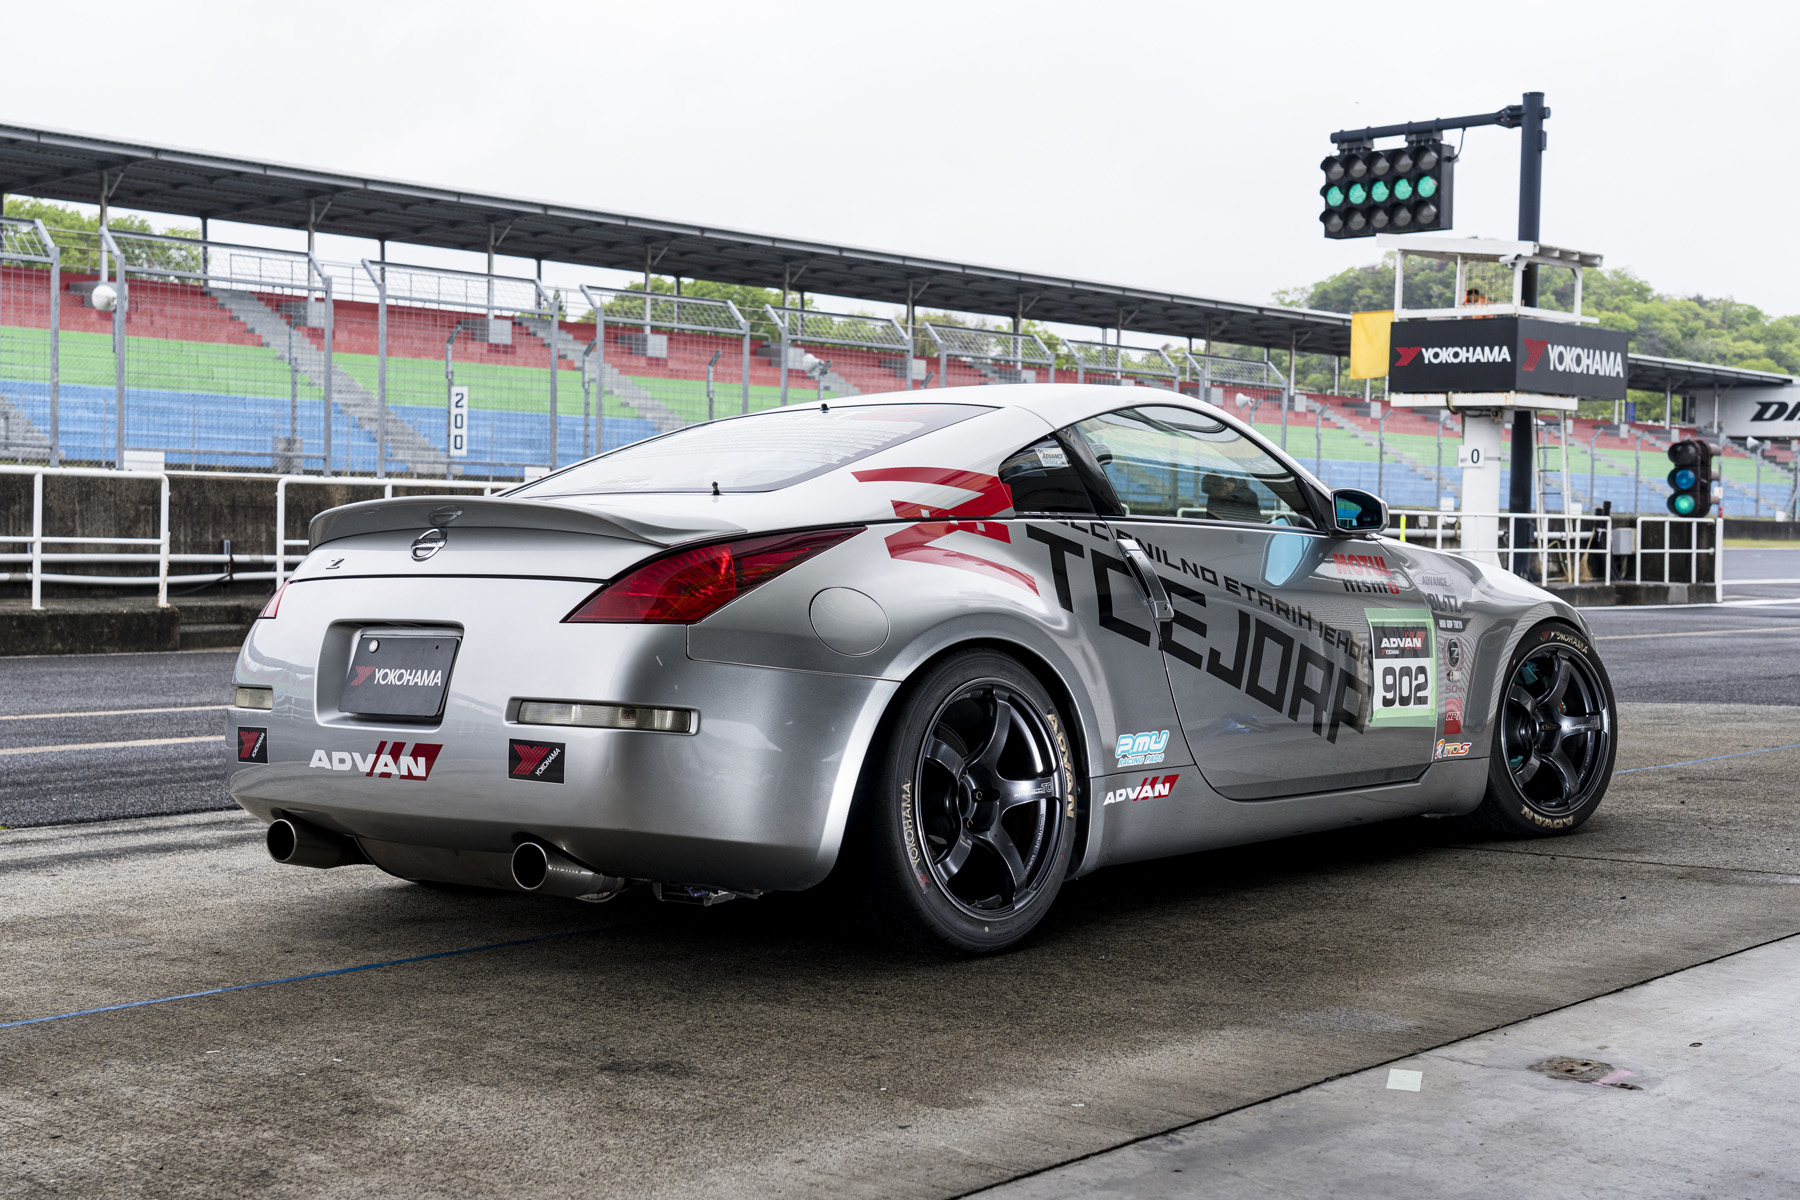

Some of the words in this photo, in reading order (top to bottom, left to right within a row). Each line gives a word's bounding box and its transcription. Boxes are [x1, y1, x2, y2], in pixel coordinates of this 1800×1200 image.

[1421, 345, 1511, 364] YOKOHAMA
[1547, 343, 1624, 378] YOKOHAMA
[454, 392, 464, 450] 200
[1471, 448, 1480, 464] 0
[1332, 553, 1393, 577] MOTUL
[1223, 575, 1312, 632] ETARIH
[1427, 593, 1462, 613] BLITZ
[1025, 523, 1372, 745] TCEJORP
[1380, 637, 1422, 649] ADVAN
[374, 668, 442, 687] YOKOHAMA
[1382, 665, 1429, 708] 902
[308, 748, 427, 777] ADVAN
[534, 747, 562, 777] YOKOHAMA
[1045, 713, 1075, 819] ADVAN
[1117, 755, 1146, 768] RACING
[1144, 752, 1165, 765] PADS
[1103, 782, 1171, 806] ADVAN
[901, 780, 921, 869] YOKOHAMA
[1520, 804, 1574, 829] ADVAN
